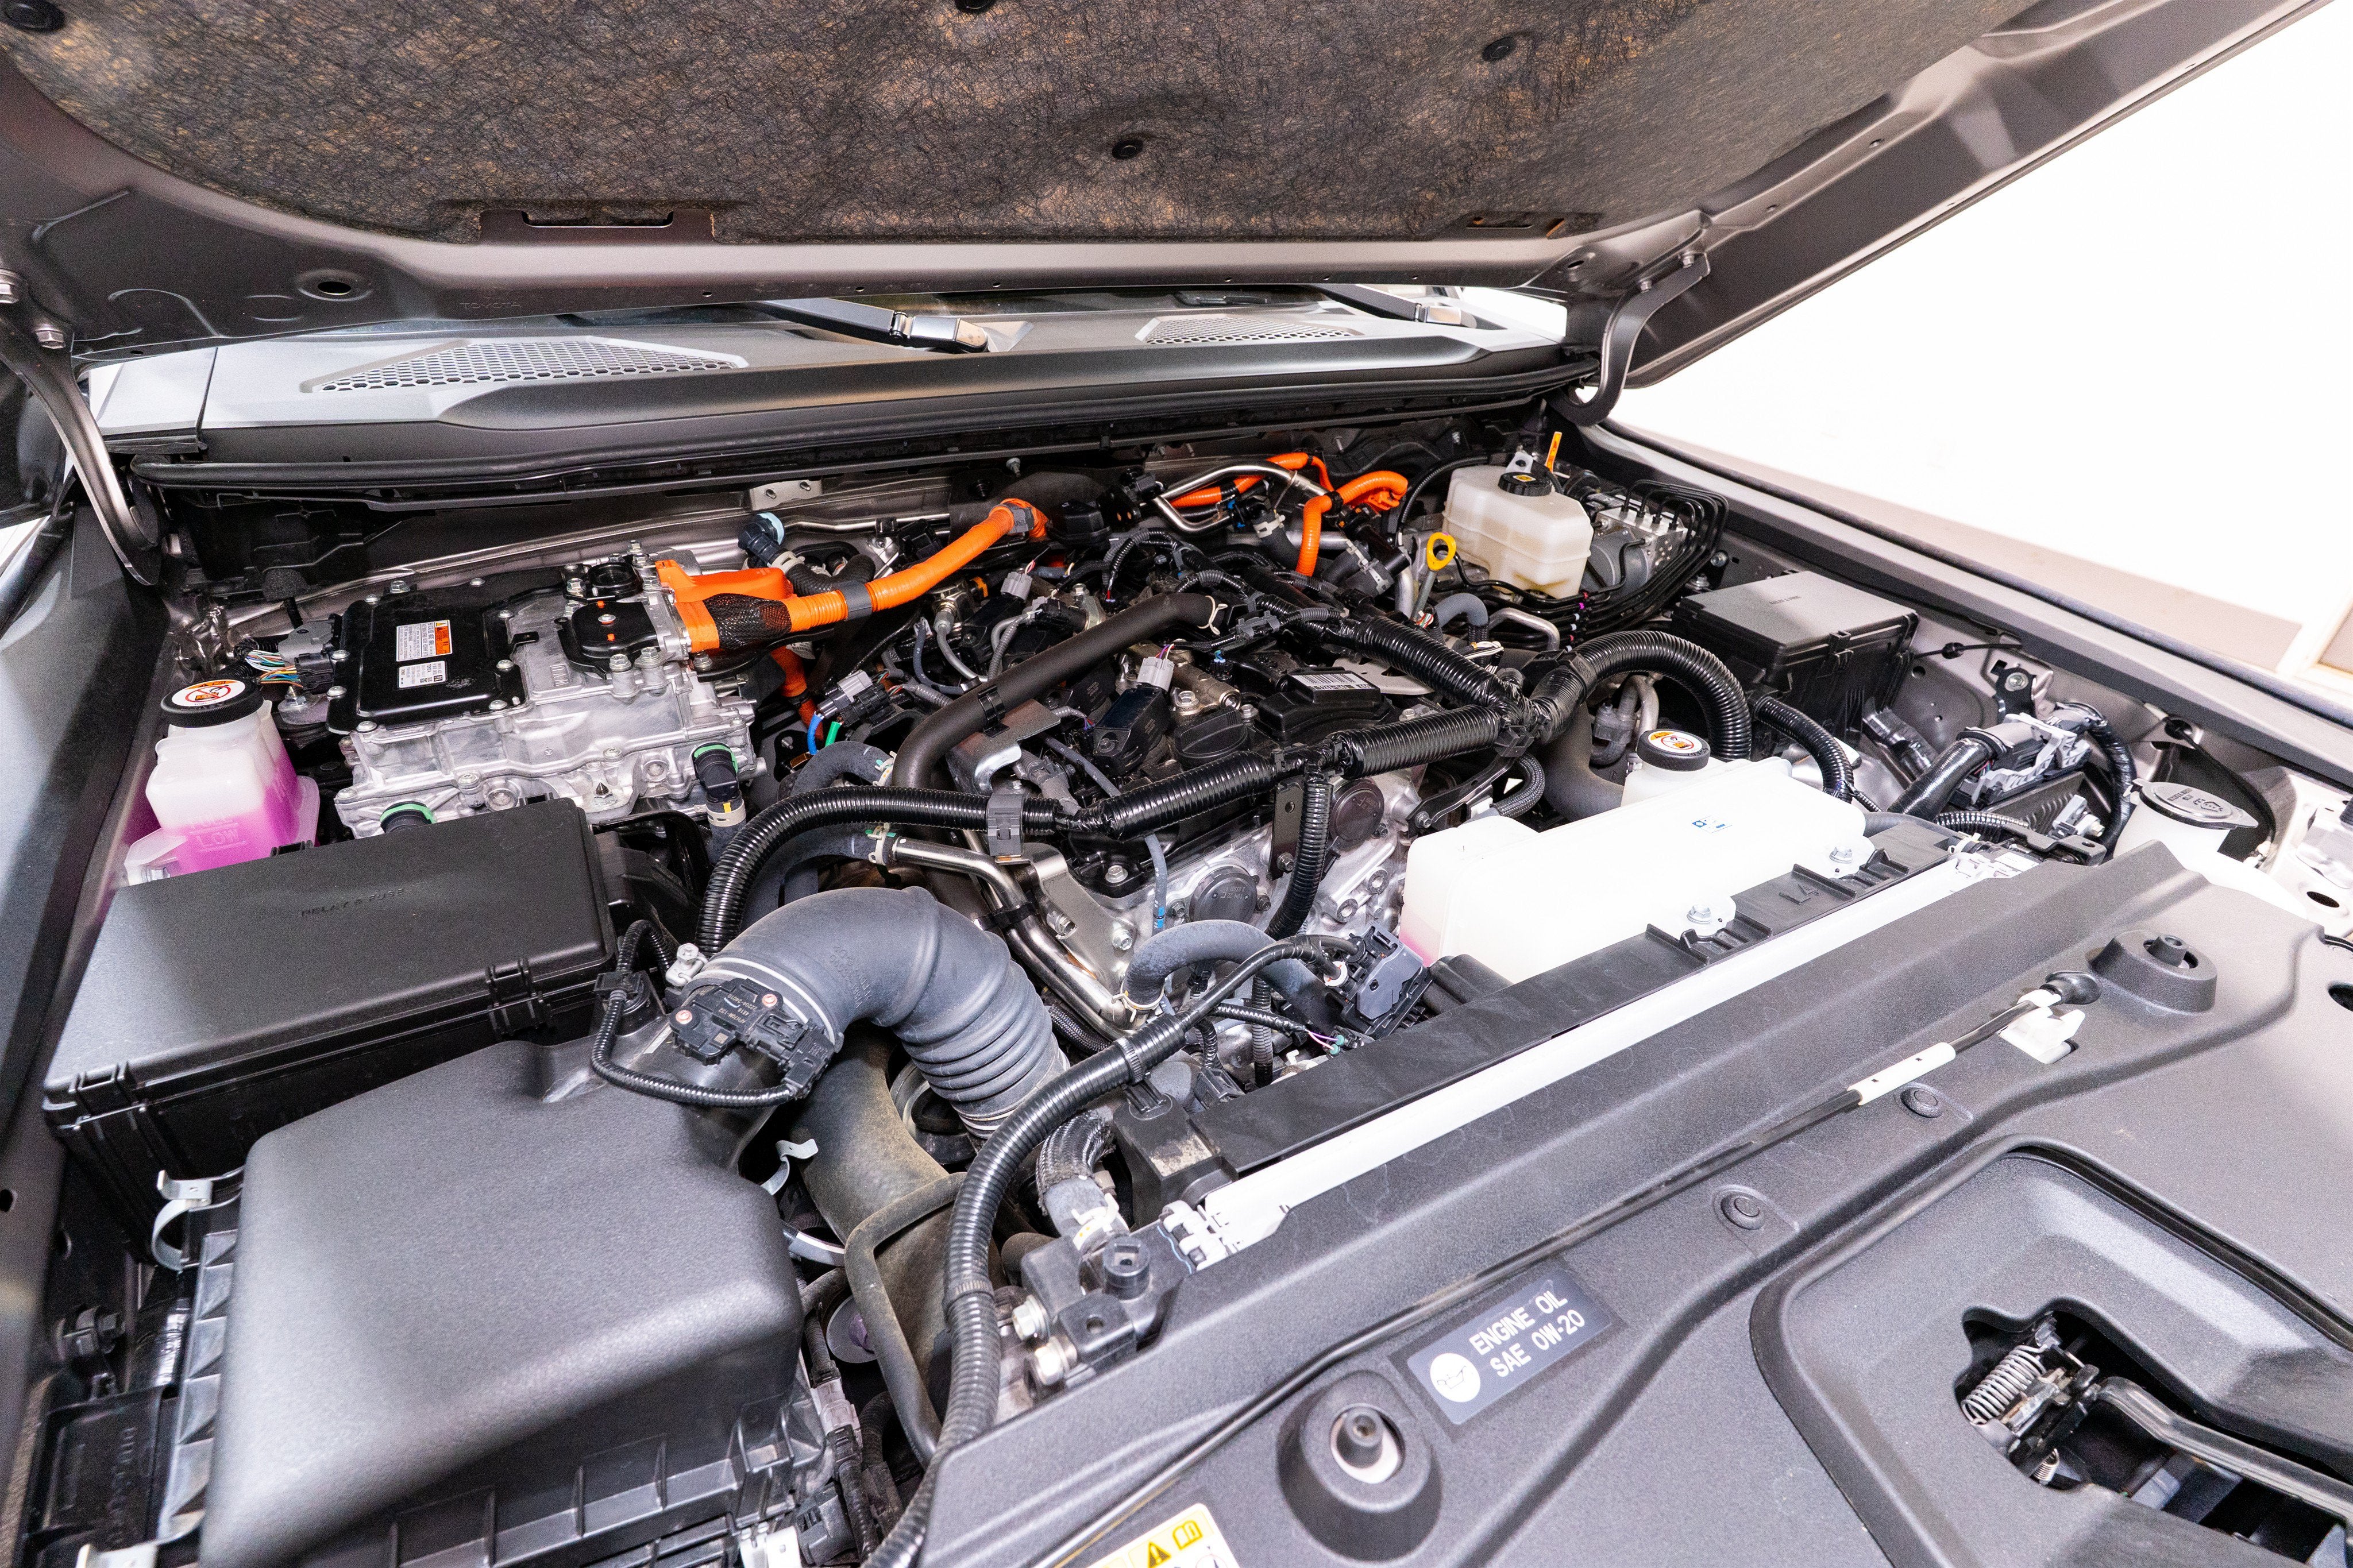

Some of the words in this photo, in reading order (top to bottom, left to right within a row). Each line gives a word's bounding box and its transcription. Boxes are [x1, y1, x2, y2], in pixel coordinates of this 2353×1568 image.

[459, 302, 522, 311] TOYOTA
[196, 829, 239, 847] LOW
[368, 888, 404, 902] FUSE
[1779, 884, 1821, 905] L4
[1469, 1306, 1536, 1355] ENGINE
[1535, 1289, 1568, 1314] OIL
[1490, 1342, 1532, 1378] SAE
[1532, 1310, 1586, 1351] 0W-20
